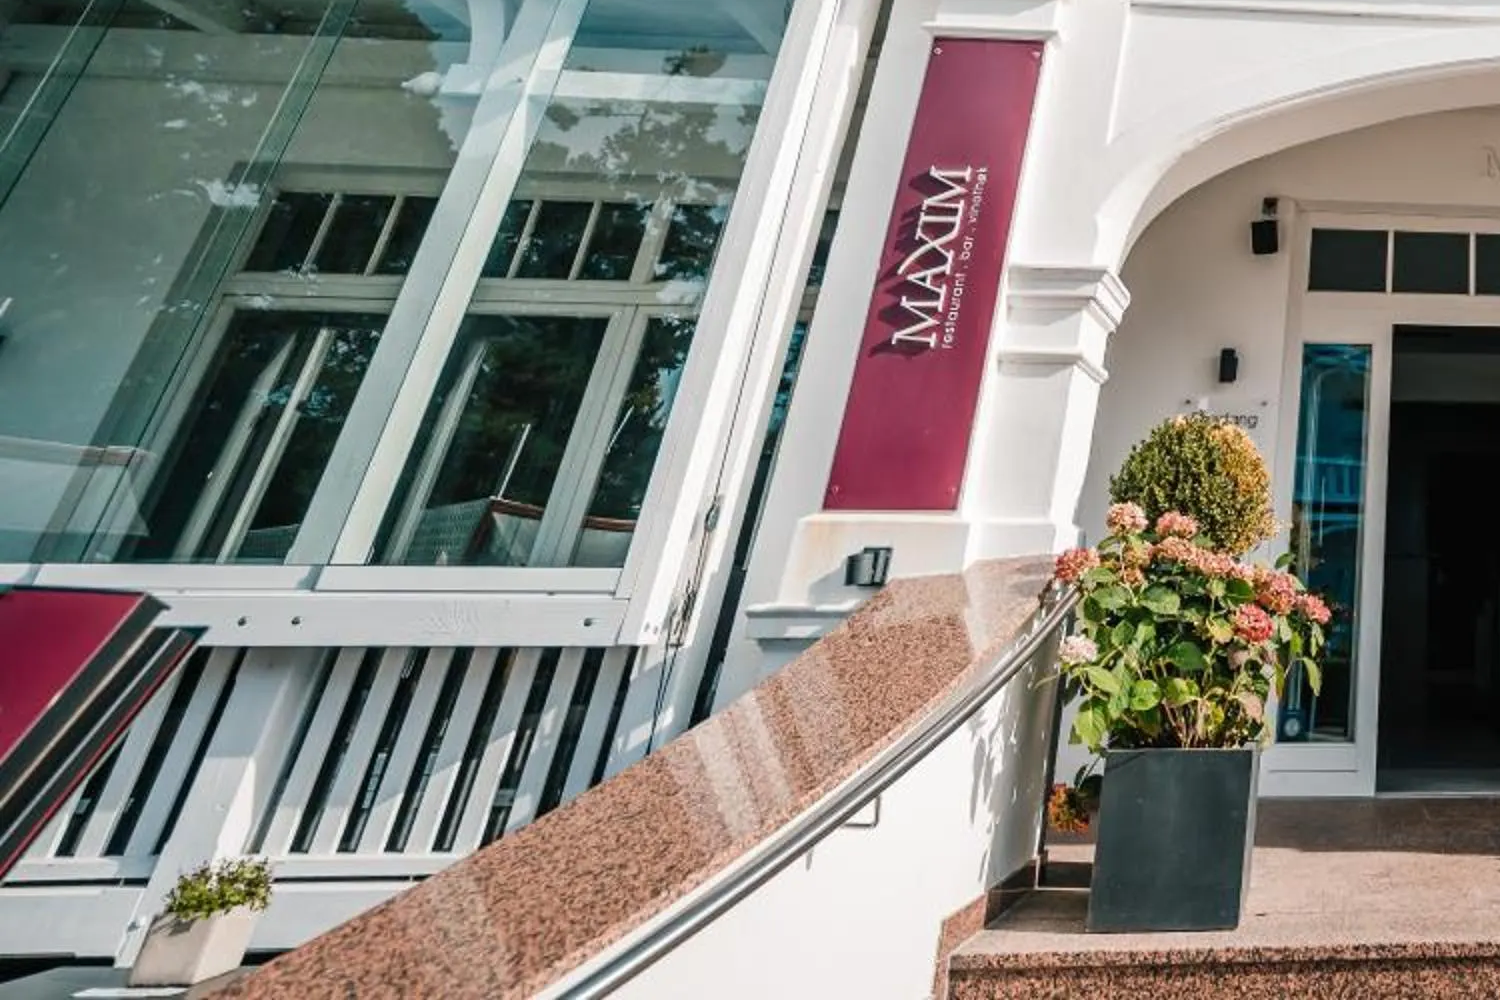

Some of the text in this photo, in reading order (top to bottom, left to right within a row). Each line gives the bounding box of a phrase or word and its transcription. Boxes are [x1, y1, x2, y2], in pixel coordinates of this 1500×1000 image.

[891, 165, 972, 349] MAXIM
[941, 272, 967, 349] restaurant
[959, 235, 975, 261] bar
